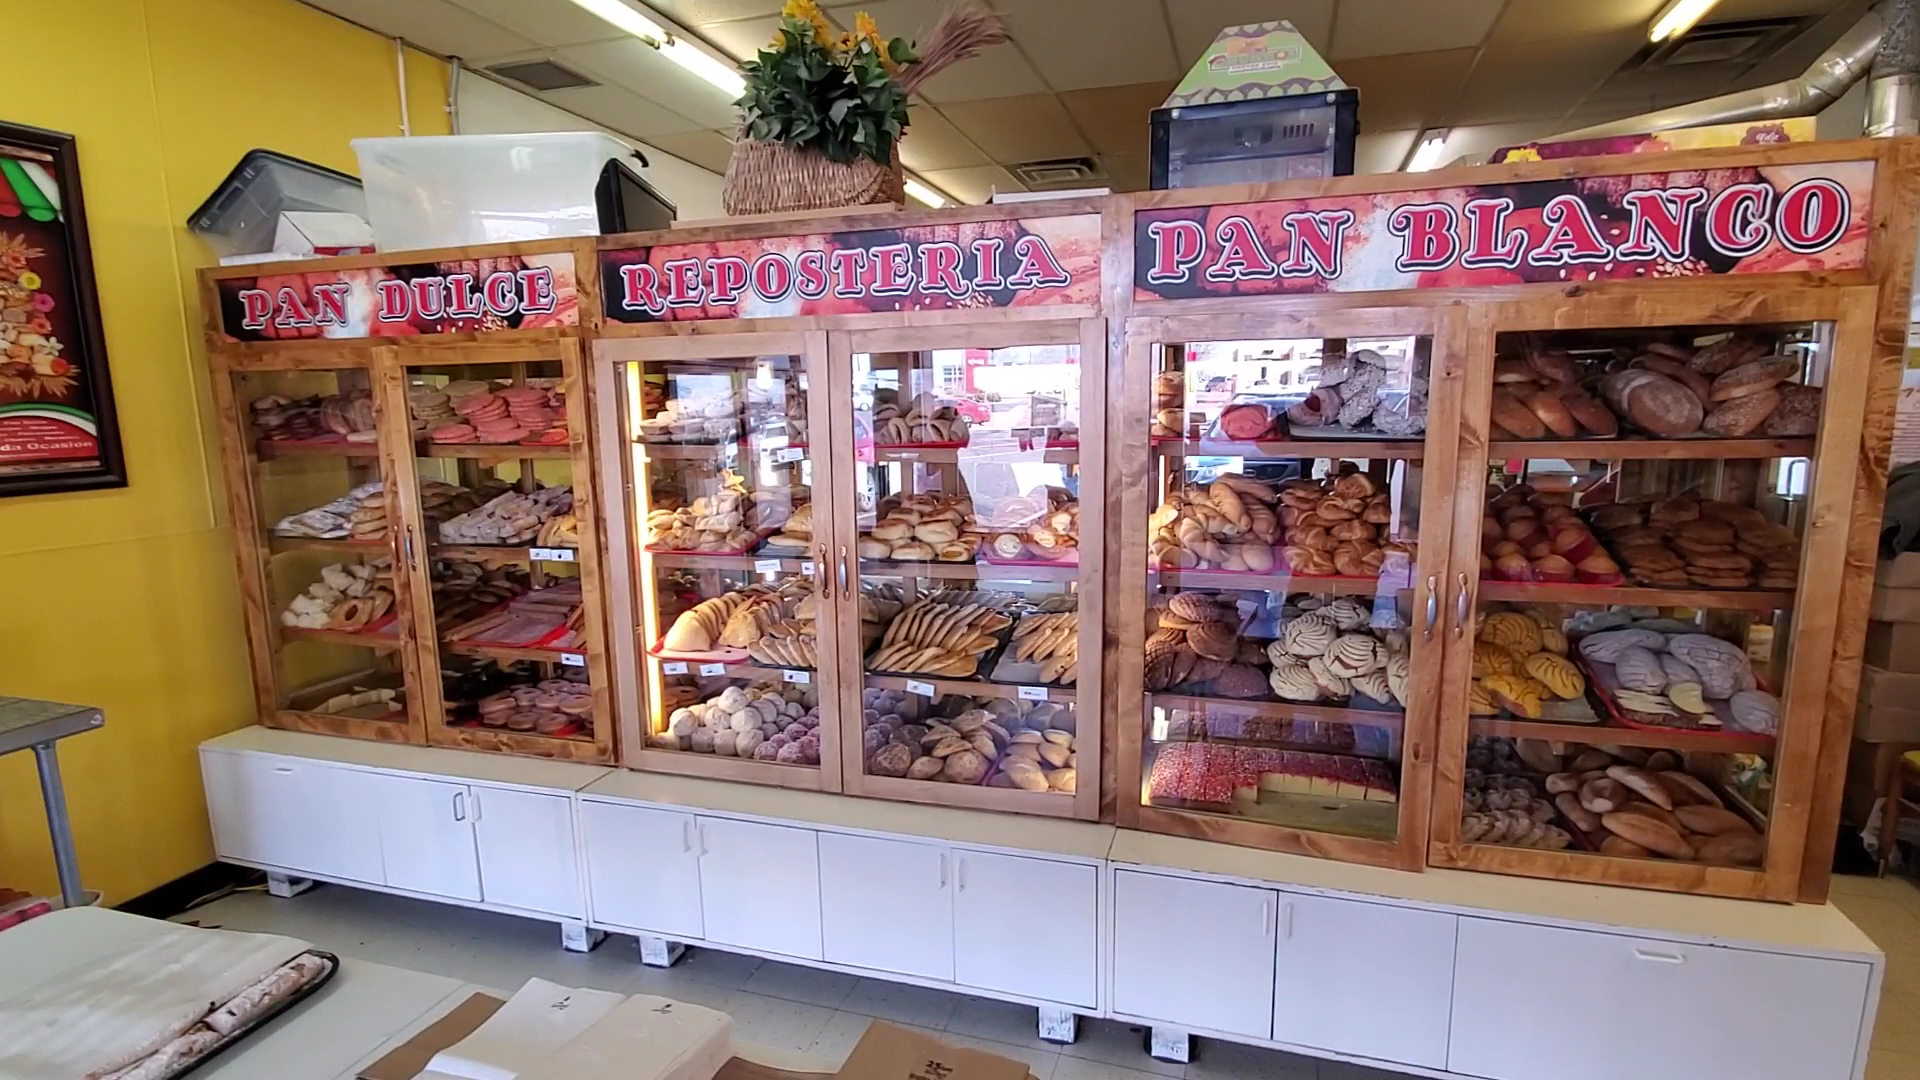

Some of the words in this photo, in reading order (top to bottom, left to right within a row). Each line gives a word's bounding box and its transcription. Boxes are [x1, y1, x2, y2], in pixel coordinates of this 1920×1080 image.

[1146, 207, 1355, 284] PAN
[1389, 178, 1852, 273] BLANCO
[239, 282, 349, 329] PAN
[376, 266, 556, 322] DULCE
[620, 235, 1070, 315] REPOSTERIA
[27, 441, 93, 450] Ocasion
